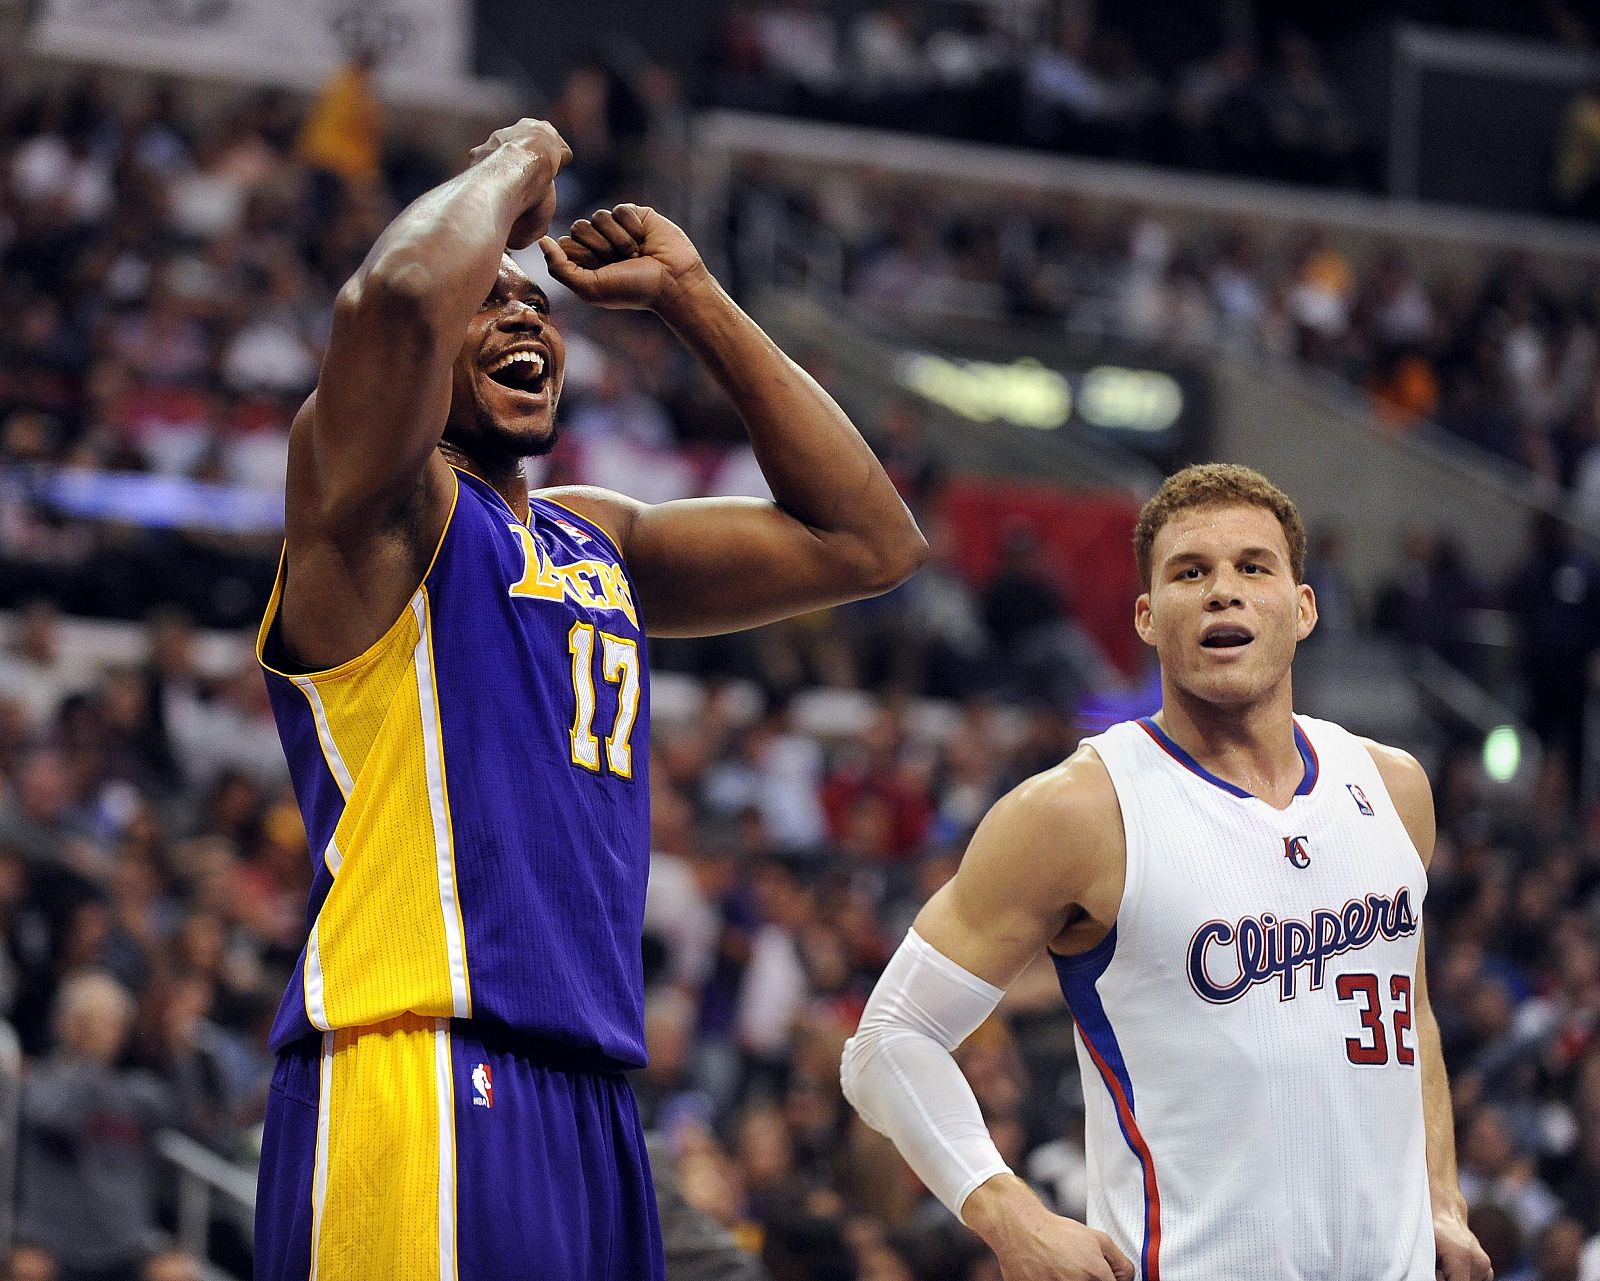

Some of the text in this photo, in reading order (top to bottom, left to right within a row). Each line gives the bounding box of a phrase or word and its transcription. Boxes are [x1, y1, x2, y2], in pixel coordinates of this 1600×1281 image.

[568, 620, 641, 779] 17
[1186, 886, 1418, 1005] Clippers
[1335, 972, 1415, 1066] 32
[473, 1096, 487, 1106] NBA
